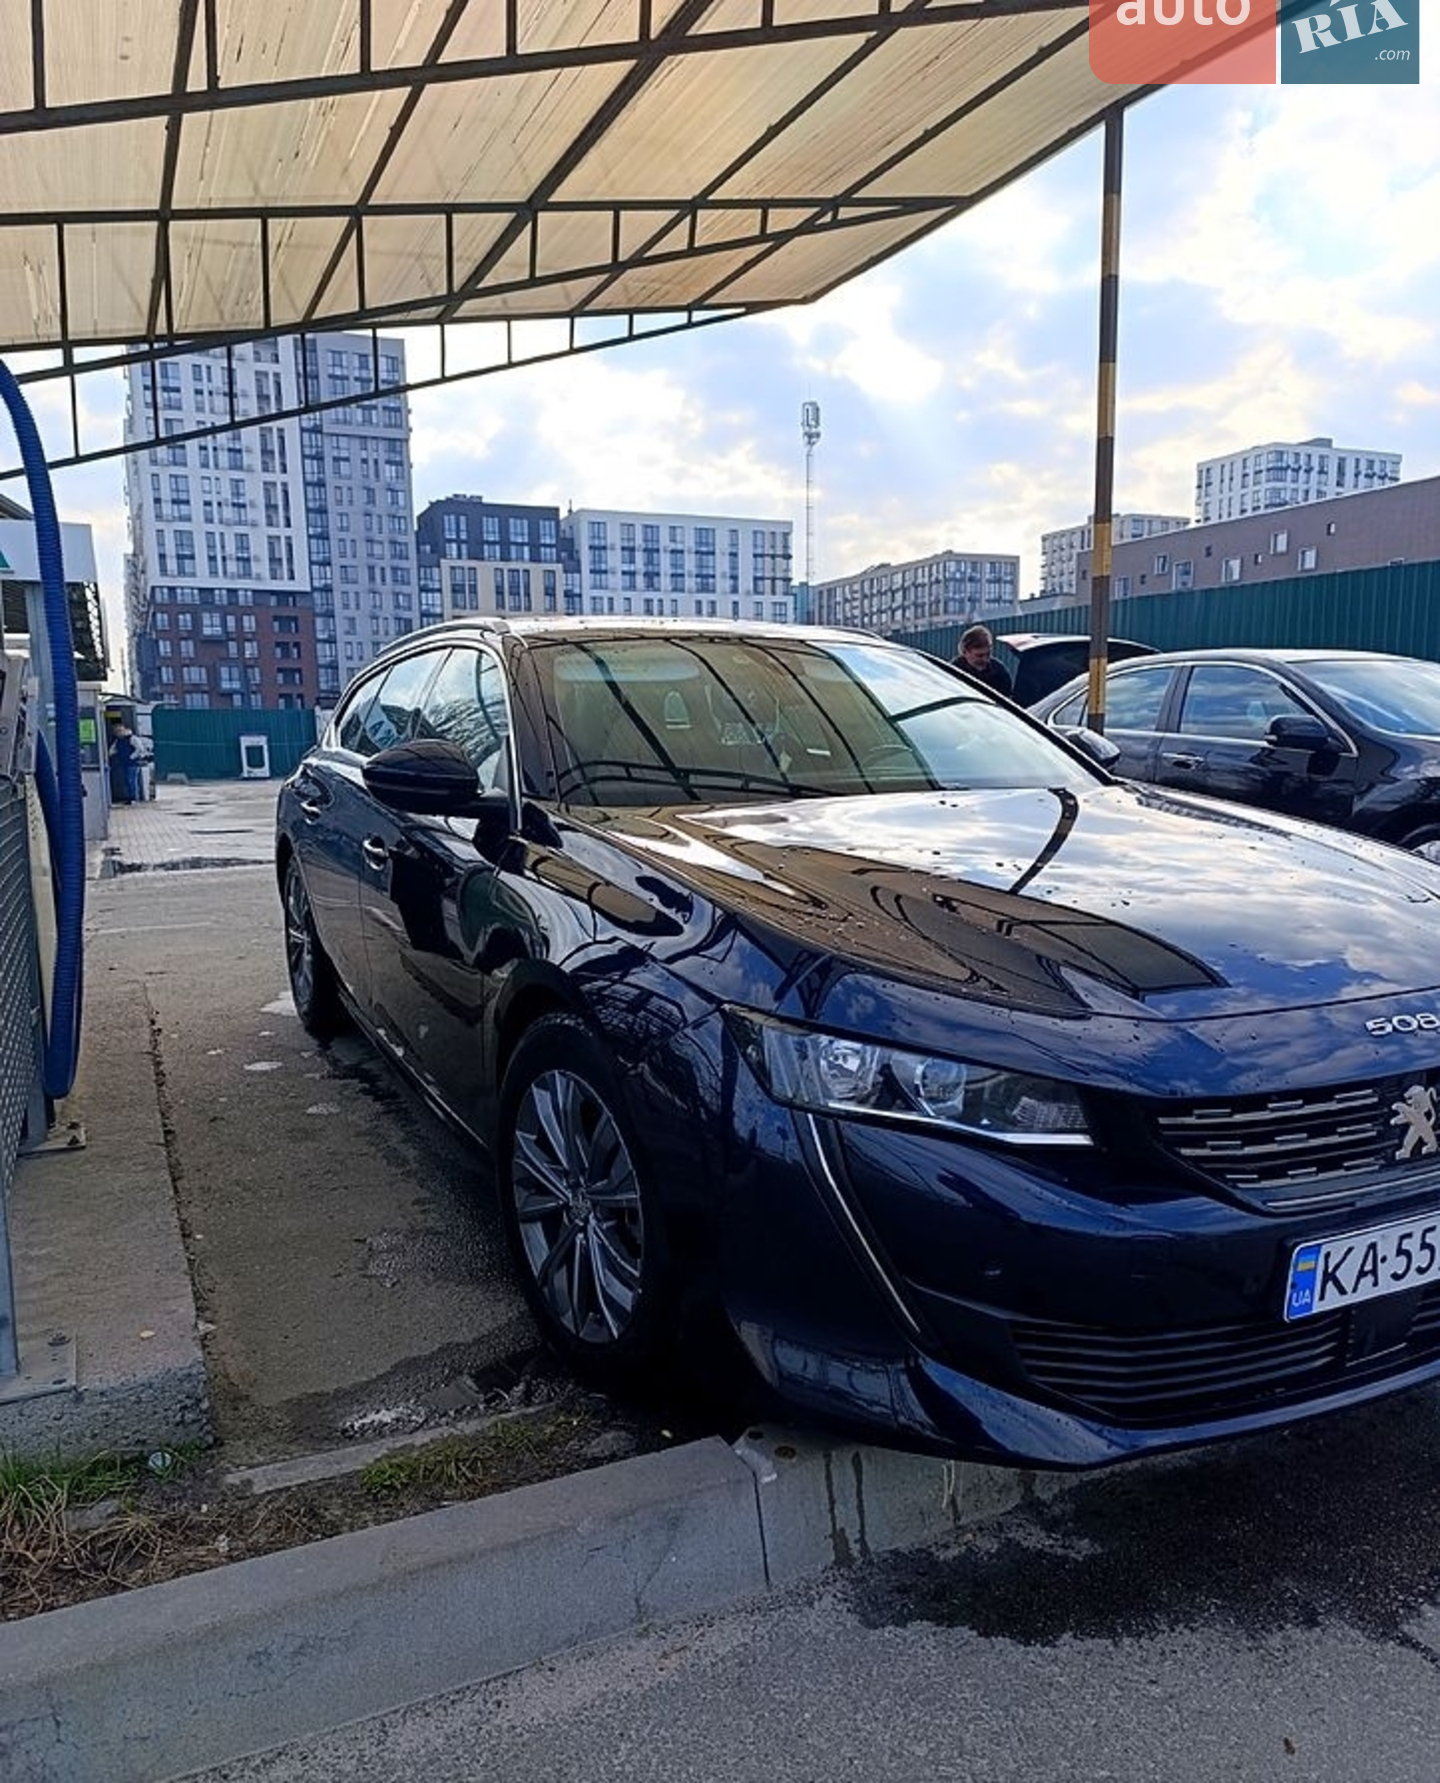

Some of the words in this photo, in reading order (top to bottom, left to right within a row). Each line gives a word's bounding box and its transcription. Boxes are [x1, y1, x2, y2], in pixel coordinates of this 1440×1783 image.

[1365, 1012, 1440, 1035] 508
[1318, 1225, 1440, 1302] KA·55
[1291, 1288, 1311, 1307] UA
